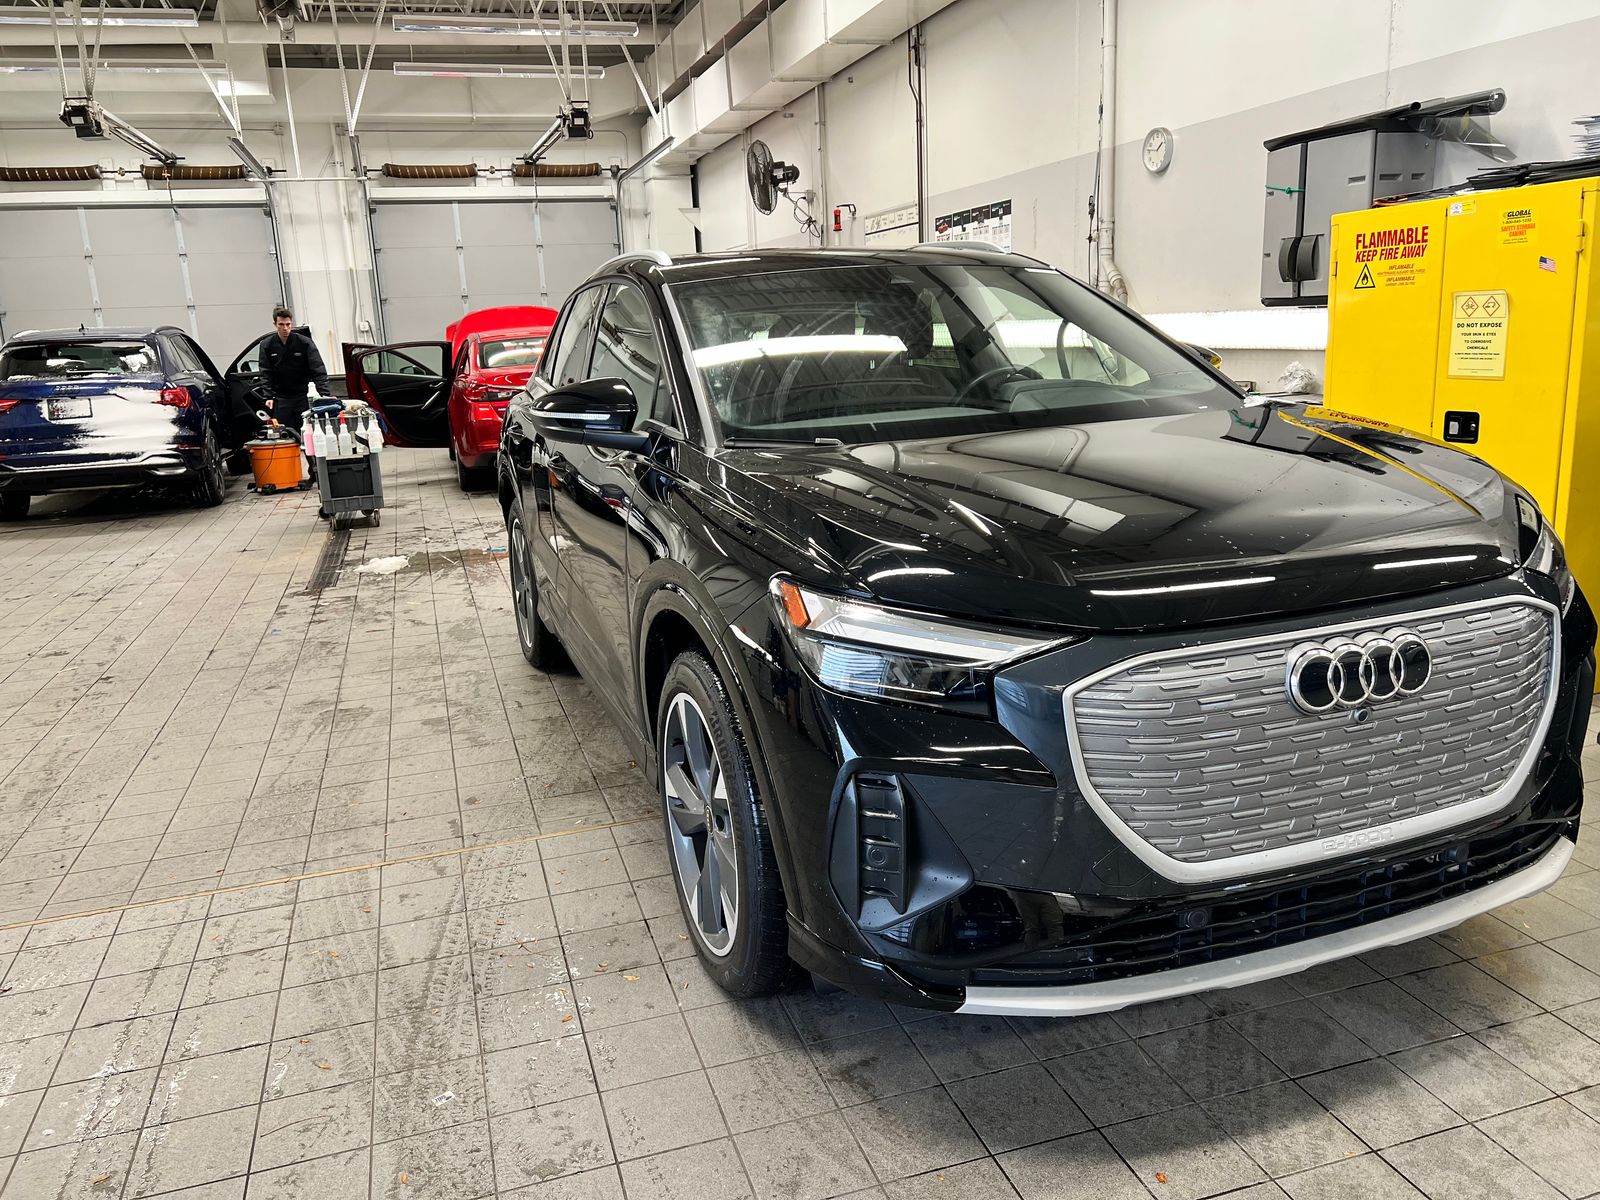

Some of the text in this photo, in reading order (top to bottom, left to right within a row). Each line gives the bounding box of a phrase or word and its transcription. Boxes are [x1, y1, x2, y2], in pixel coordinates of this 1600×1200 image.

[1507, 209, 1531, 217] GLOBAL
[1356, 226, 1429, 250] FLAMMABLE
[1355, 244, 1428, 263] KEEP FIRE AWAY
[1321, 827, 1393, 852] e-tron
